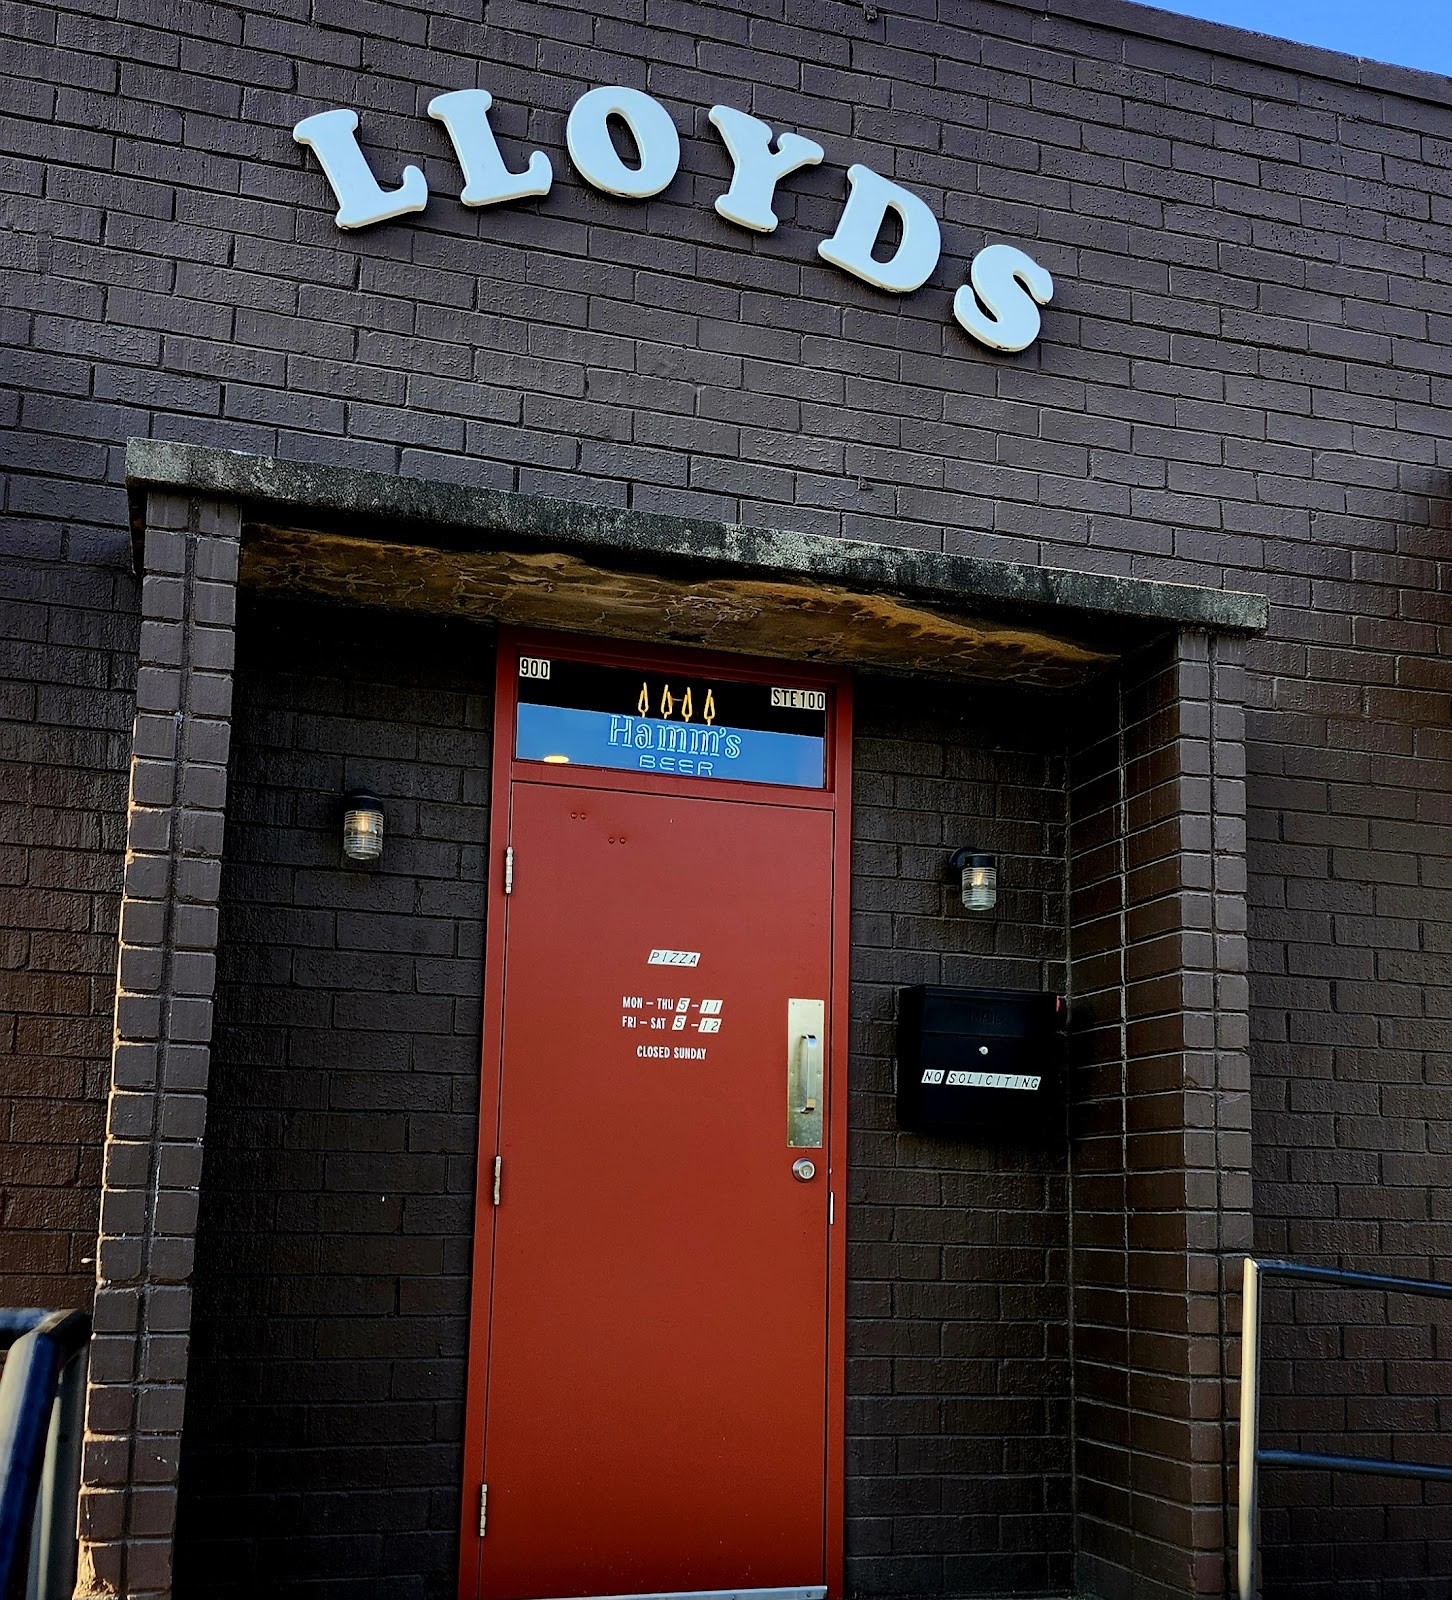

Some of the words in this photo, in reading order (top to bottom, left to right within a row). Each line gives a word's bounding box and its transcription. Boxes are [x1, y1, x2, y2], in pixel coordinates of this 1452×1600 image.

[293, 85, 1054, 353] LLOYDS
[520, 658, 548, 678] 900
[607, 715, 742, 759] Hamm's
[639, 755, 714, 776] BEER
[650, 951, 698, 965] PIZZA
[622, 996, 643, 1009] MON
[657, 997, 674, 1010] THU
[622, 1016, 637, 1028] FRI
[650, 1017, 666, 1029] SAT
[637, 1045, 670, 1058] CLOSED
[673, 1047, 707, 1060] SUNDAY
[924, 1071, 943, 1083] NO
[948, 1073, 1039, 1089] SOLICITING
